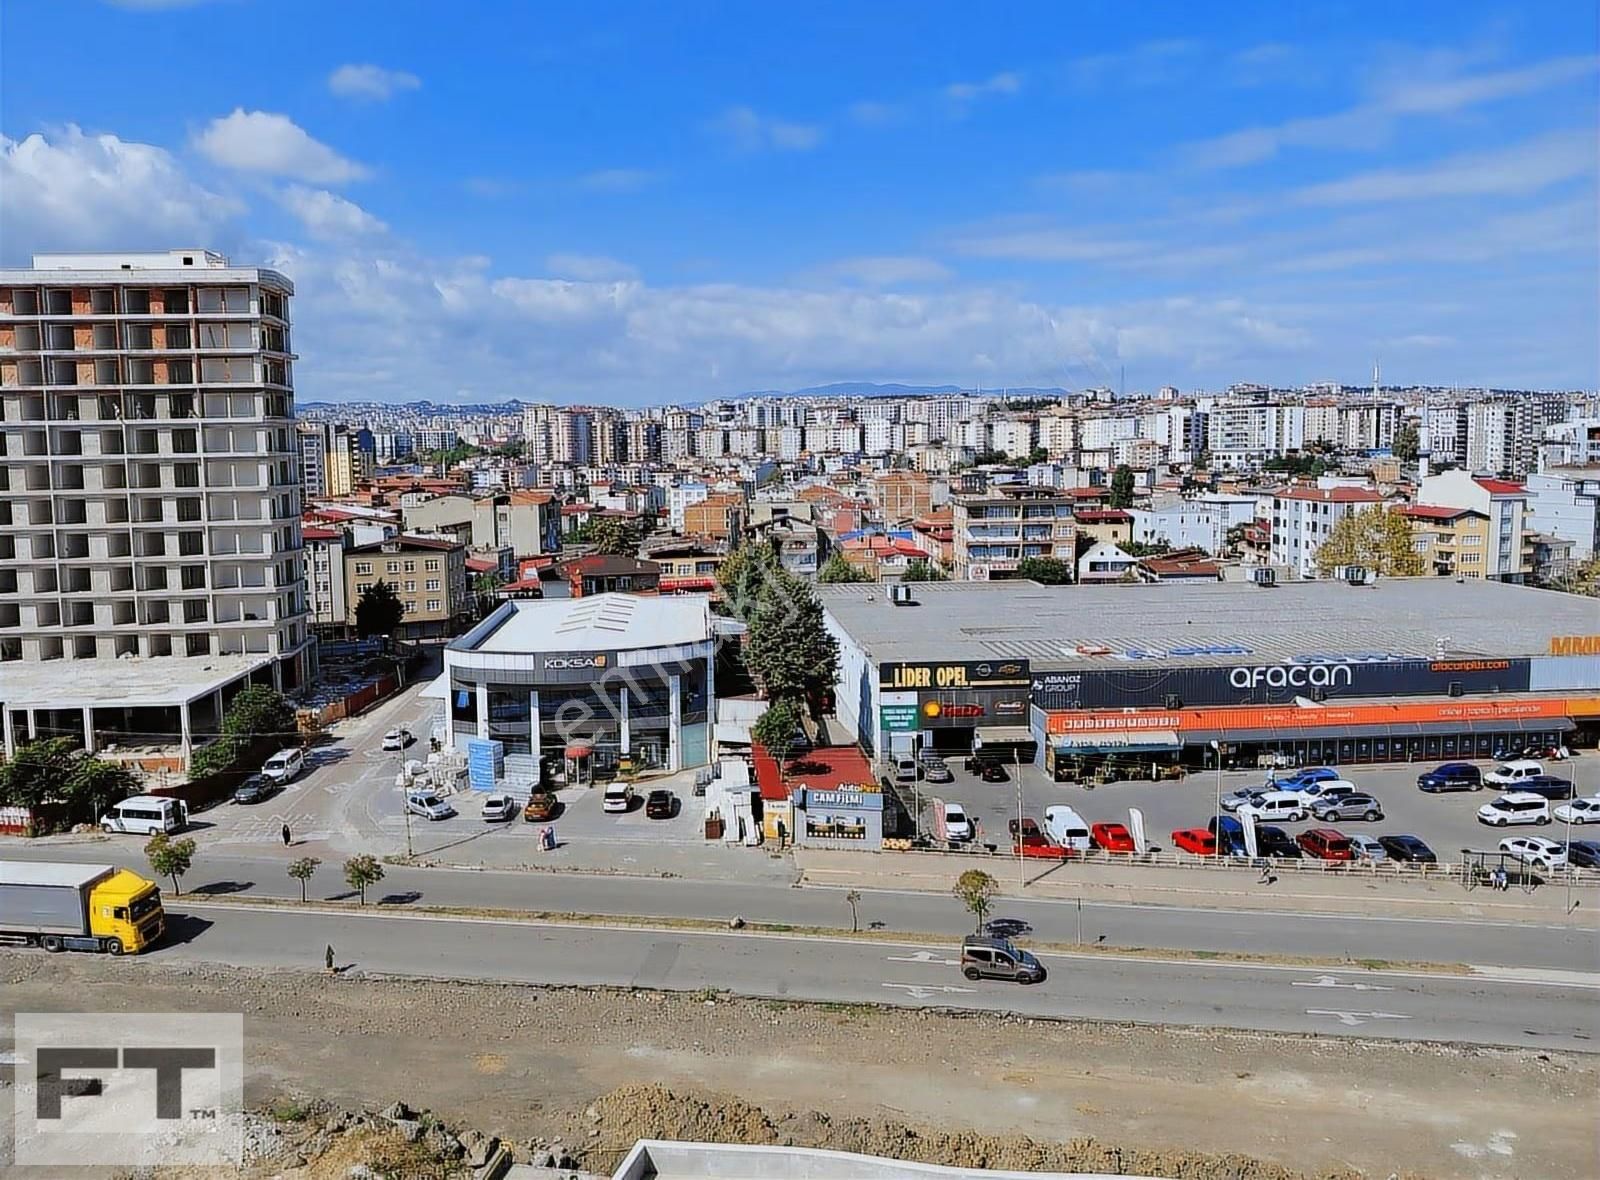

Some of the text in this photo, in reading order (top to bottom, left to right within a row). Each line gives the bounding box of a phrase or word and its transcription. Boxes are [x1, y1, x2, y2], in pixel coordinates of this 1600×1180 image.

[894, 663, 969, 687] LİDER OPEL
[1045, 684, 1076, 692] GROUP
